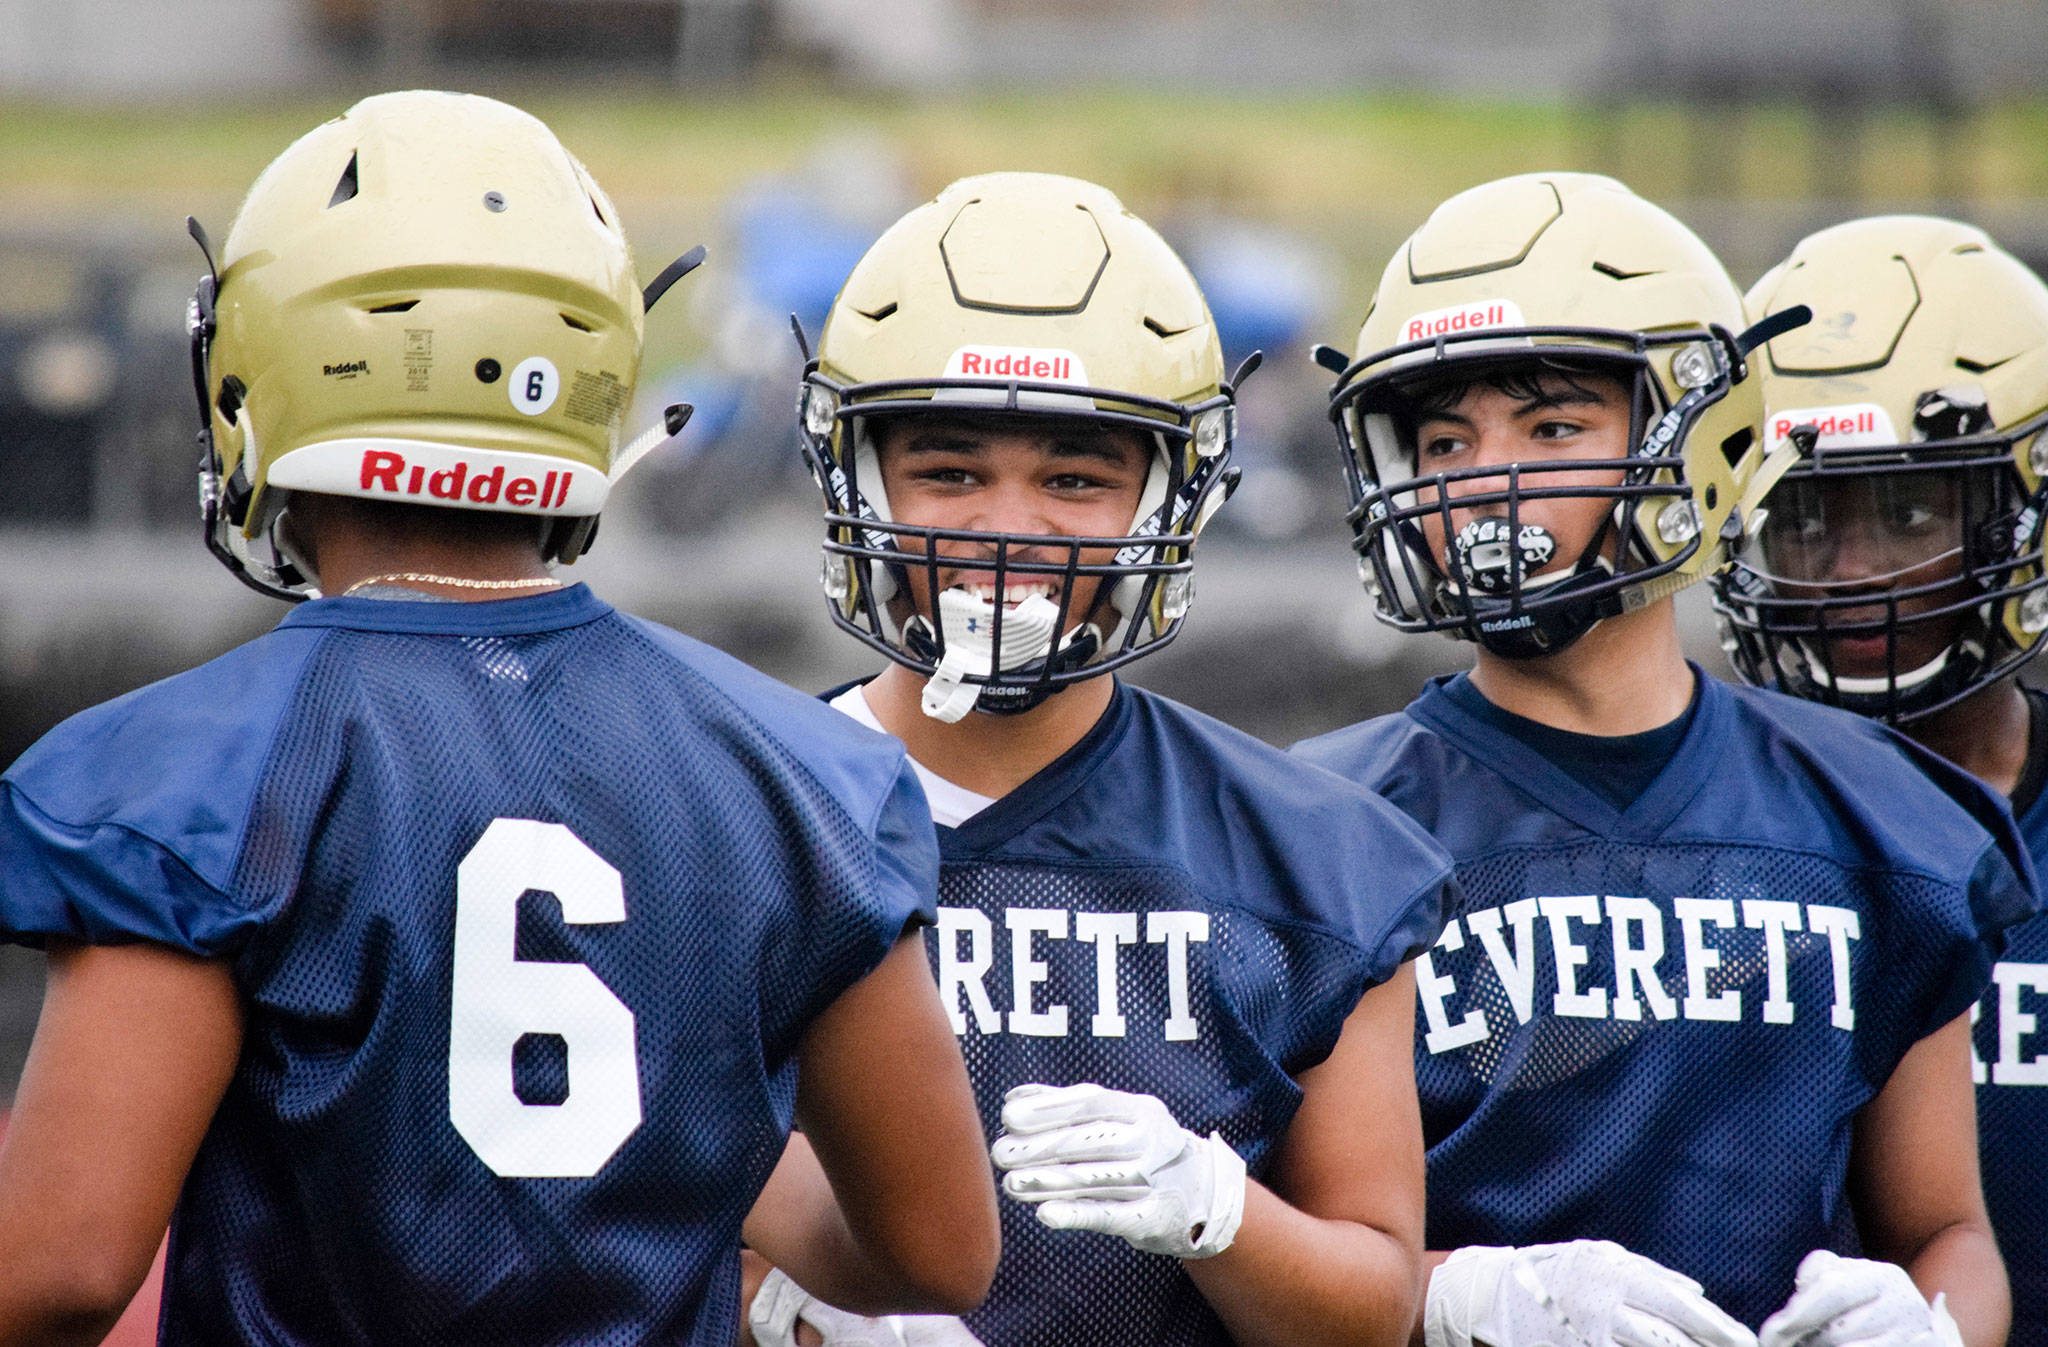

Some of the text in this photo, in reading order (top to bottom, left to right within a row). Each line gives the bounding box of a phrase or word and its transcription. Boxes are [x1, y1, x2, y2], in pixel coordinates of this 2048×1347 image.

[1407, 305, 1503, 341] Riddell
[323, 360, 367, 376] Riddell
[962, 352, 1070, 379] Riddell
[526, 371, 543, 401] 6
[360, 450, 573, 508] Riddell
[1415, 895, 1861, 1054] EVERETT
[449, 817, 643, 1178] 6
